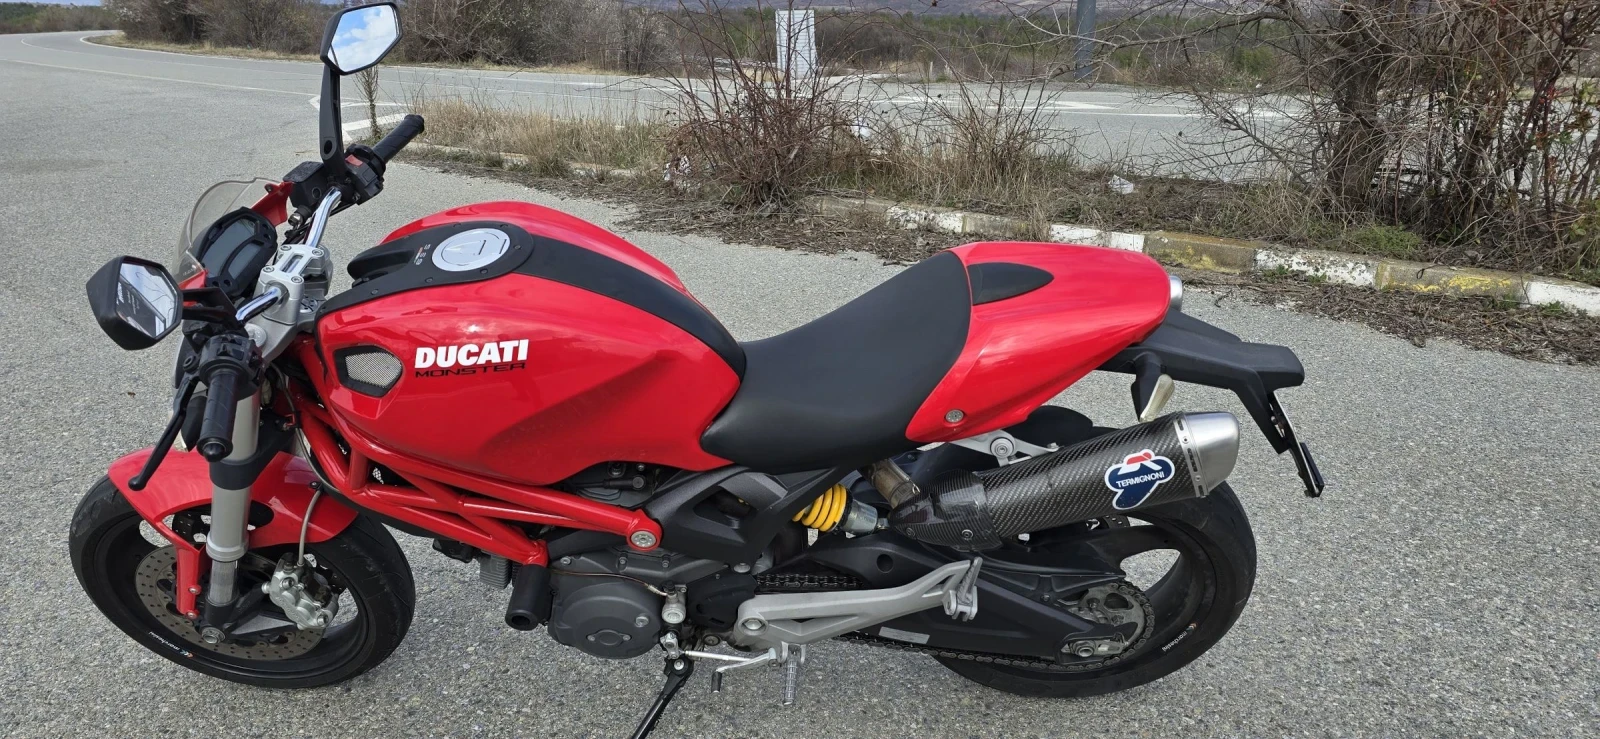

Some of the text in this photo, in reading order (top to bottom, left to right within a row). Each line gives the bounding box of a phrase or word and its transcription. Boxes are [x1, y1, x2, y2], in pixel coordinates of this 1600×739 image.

[415, 339, 529, 368] DUCATI
[415, 362, 526, 378] MONSTER
[1116, 471, 1164, 488] TERMIGNONI
